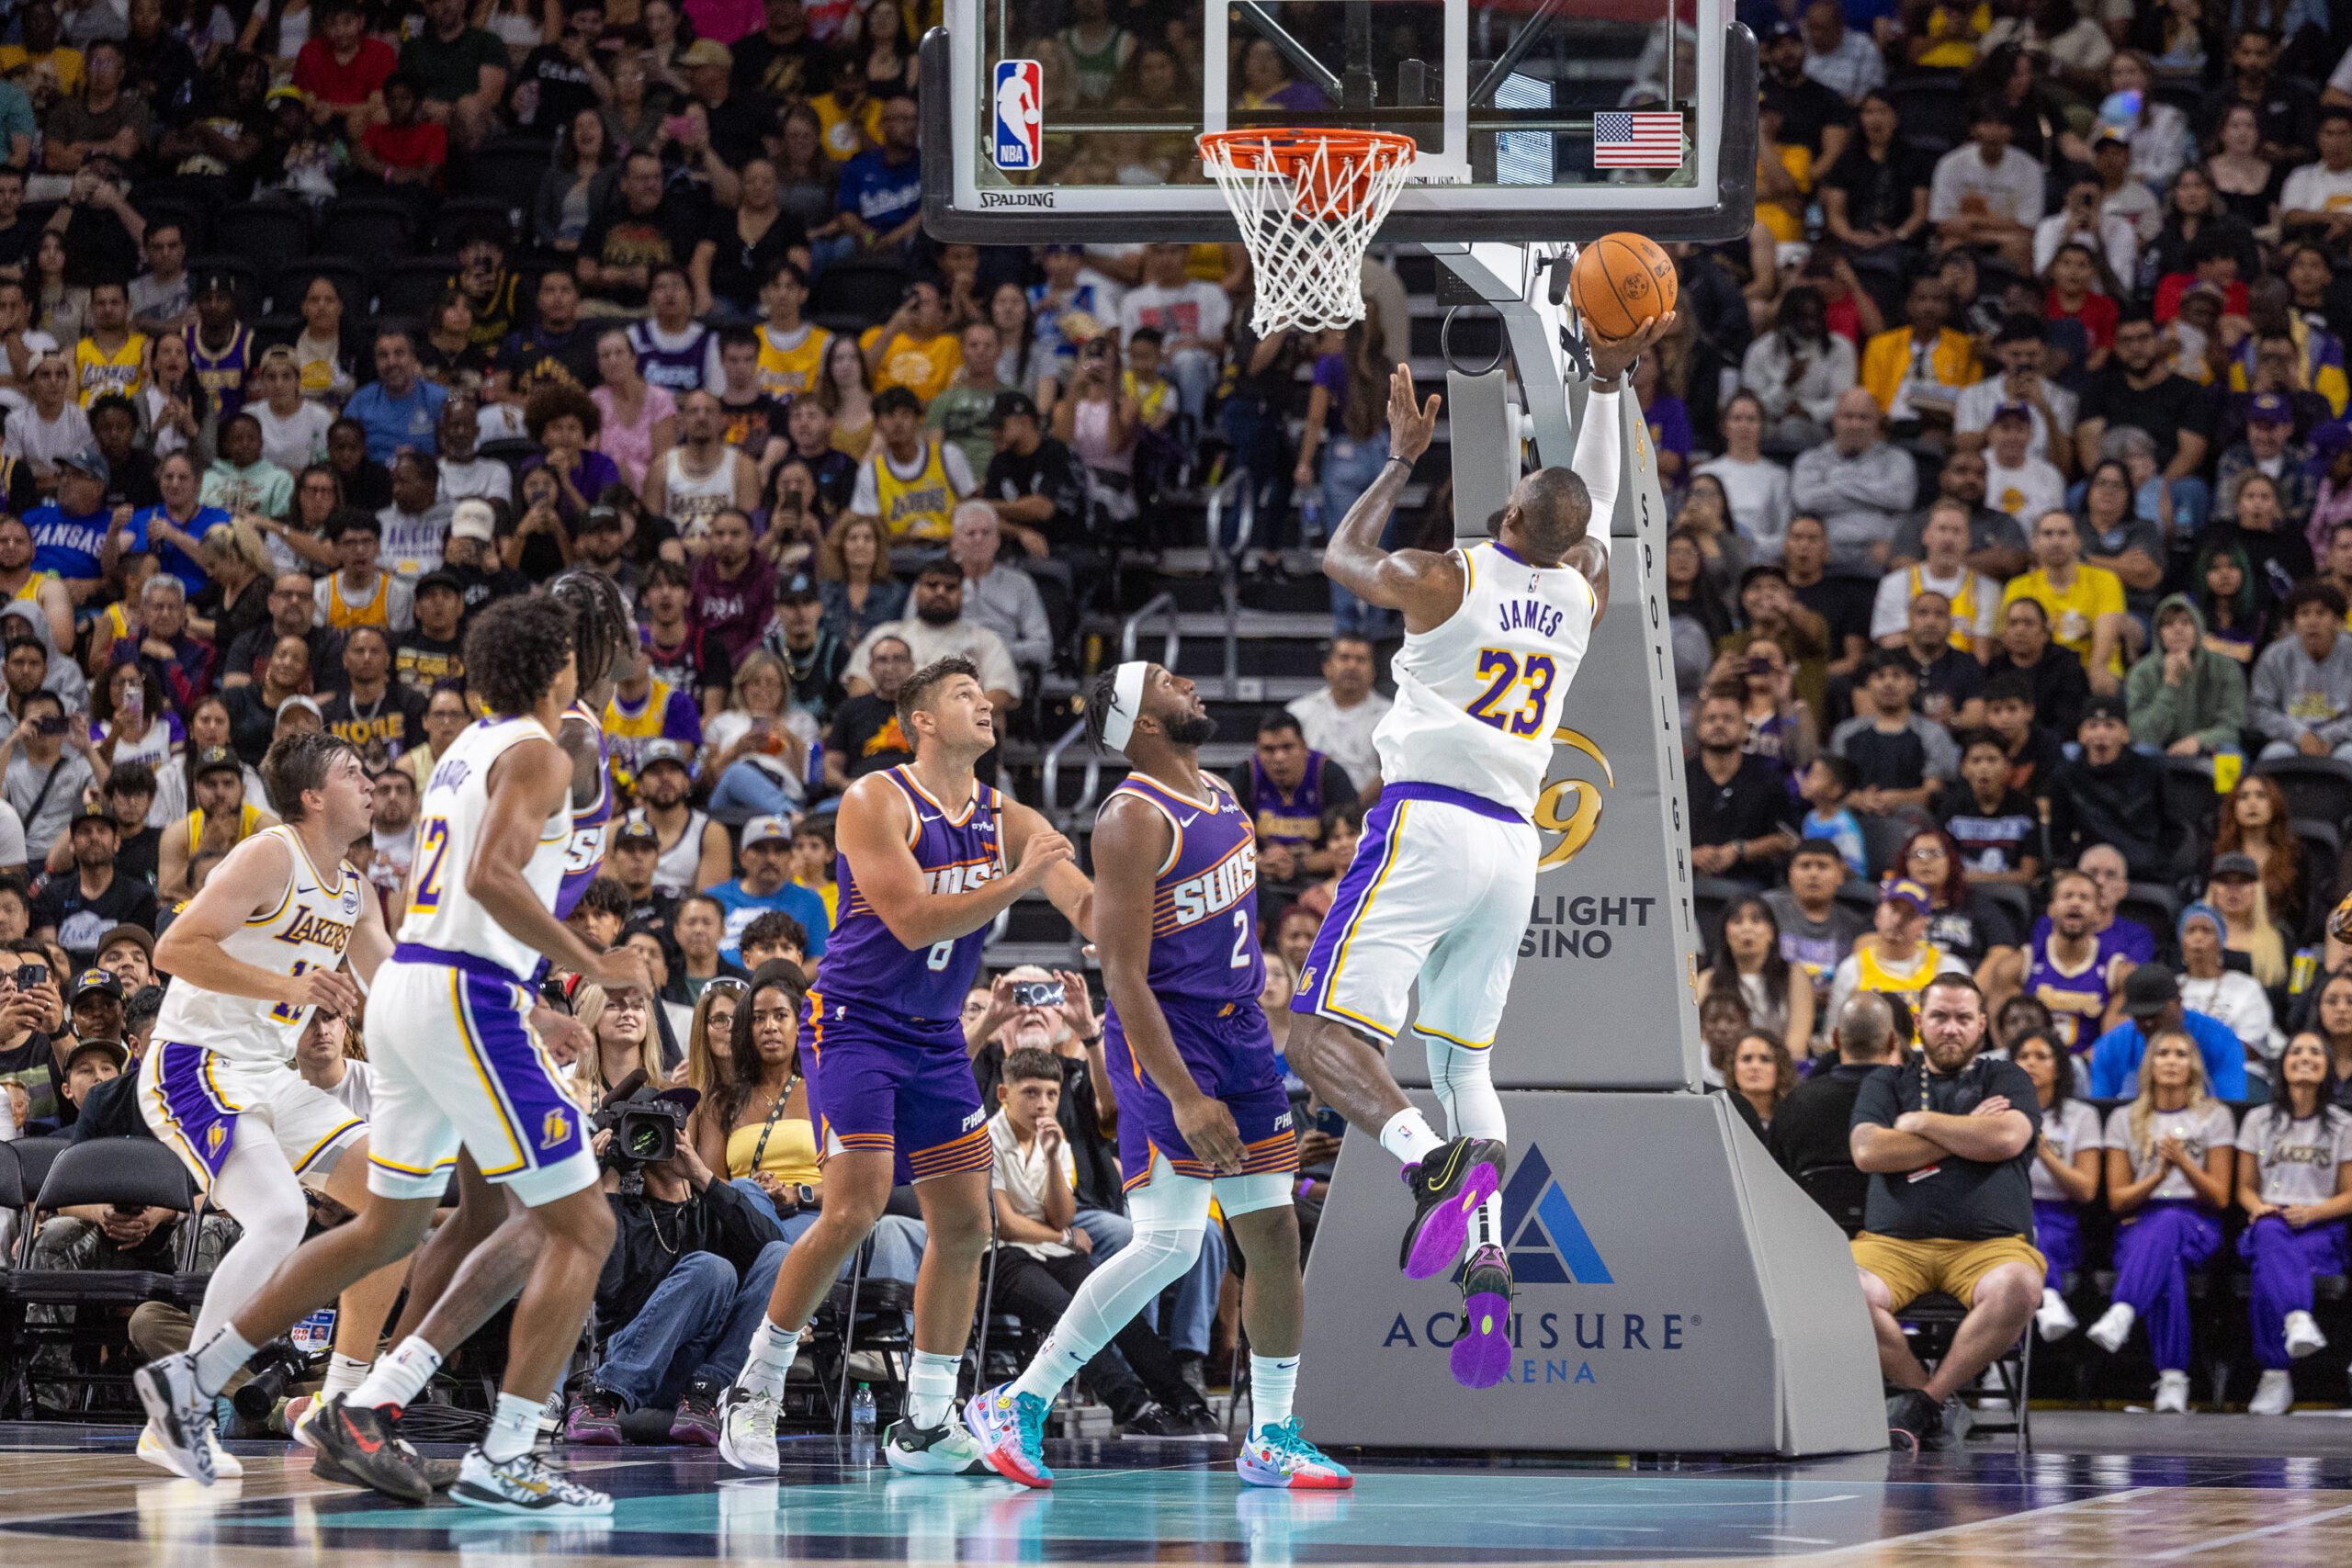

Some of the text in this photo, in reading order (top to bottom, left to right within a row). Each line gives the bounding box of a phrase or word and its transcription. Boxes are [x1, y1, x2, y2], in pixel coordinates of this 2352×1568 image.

[1001, 145, 1024, 163] NBA
[980, 192, 1056, 209] SPALDING
[1499, 599, 1563, 637] JAMES
[1464, 647, 1557, 740] 23
[1641, 492, 1689, 933] SPOTLIGHT
[1174, 838, 1256, 926] SUNS
[275, 904, 353, 954] LAKERS
[1529, 896, 1656, 927] LIGHT
[1230, 909, 1250, 969] 2
[1517, 929, 1611, 959] SINO
[1382, 1312, 1683, 1350] ACISURE
